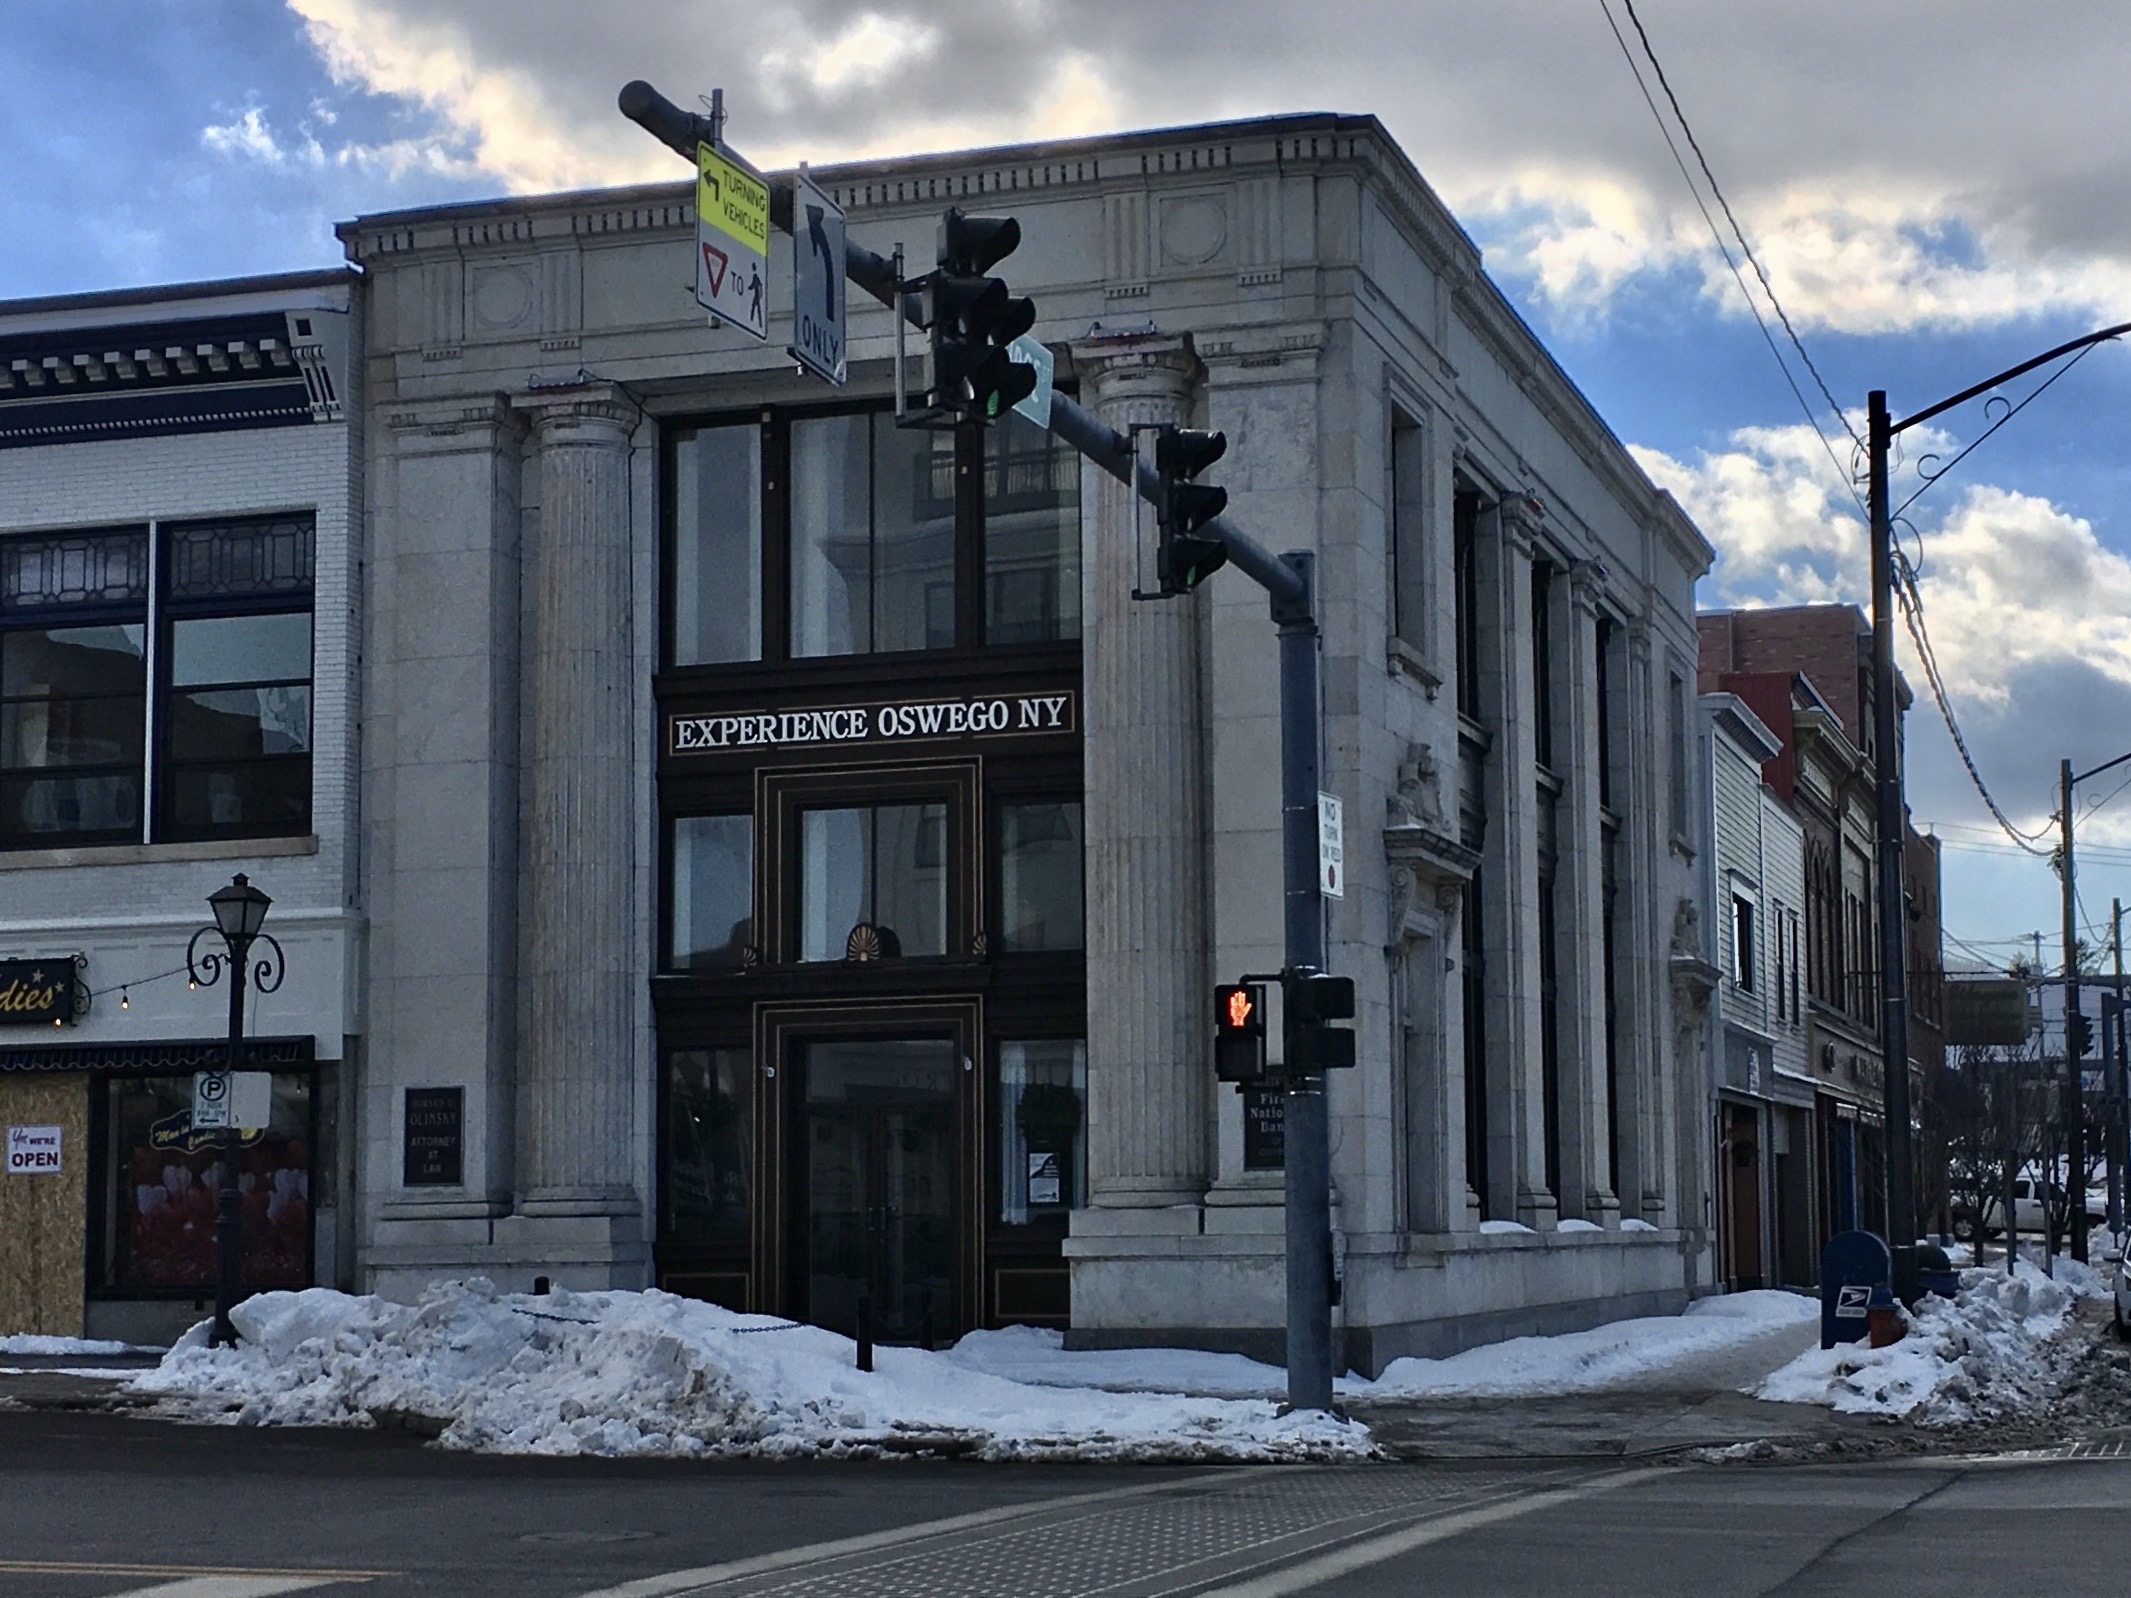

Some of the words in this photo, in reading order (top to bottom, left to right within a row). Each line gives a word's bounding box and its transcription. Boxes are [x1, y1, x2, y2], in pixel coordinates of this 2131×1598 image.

[722, 169, 766, 212] TURNING
[722, 199, 765, 240] VEHICLES
[730, 271, 744, 296] TO
[803, 314, 839, 366] ONLY
[675, 709, 867, 749] EXPERIENCE
[878, 701, 1008, 737] OSWEGO
[1018, 697, 1067, 729] NY
[0, 978, 55, 1012] dies
[207, 1081, 221, 1097] P
[1261, 1093, 1284, 1104] Fir
[1250, 1107, 1283, 1119] Natio
[1261, 1121, 1284, 1133] Ban
[12, 1152, 58, 1168] OPEN
